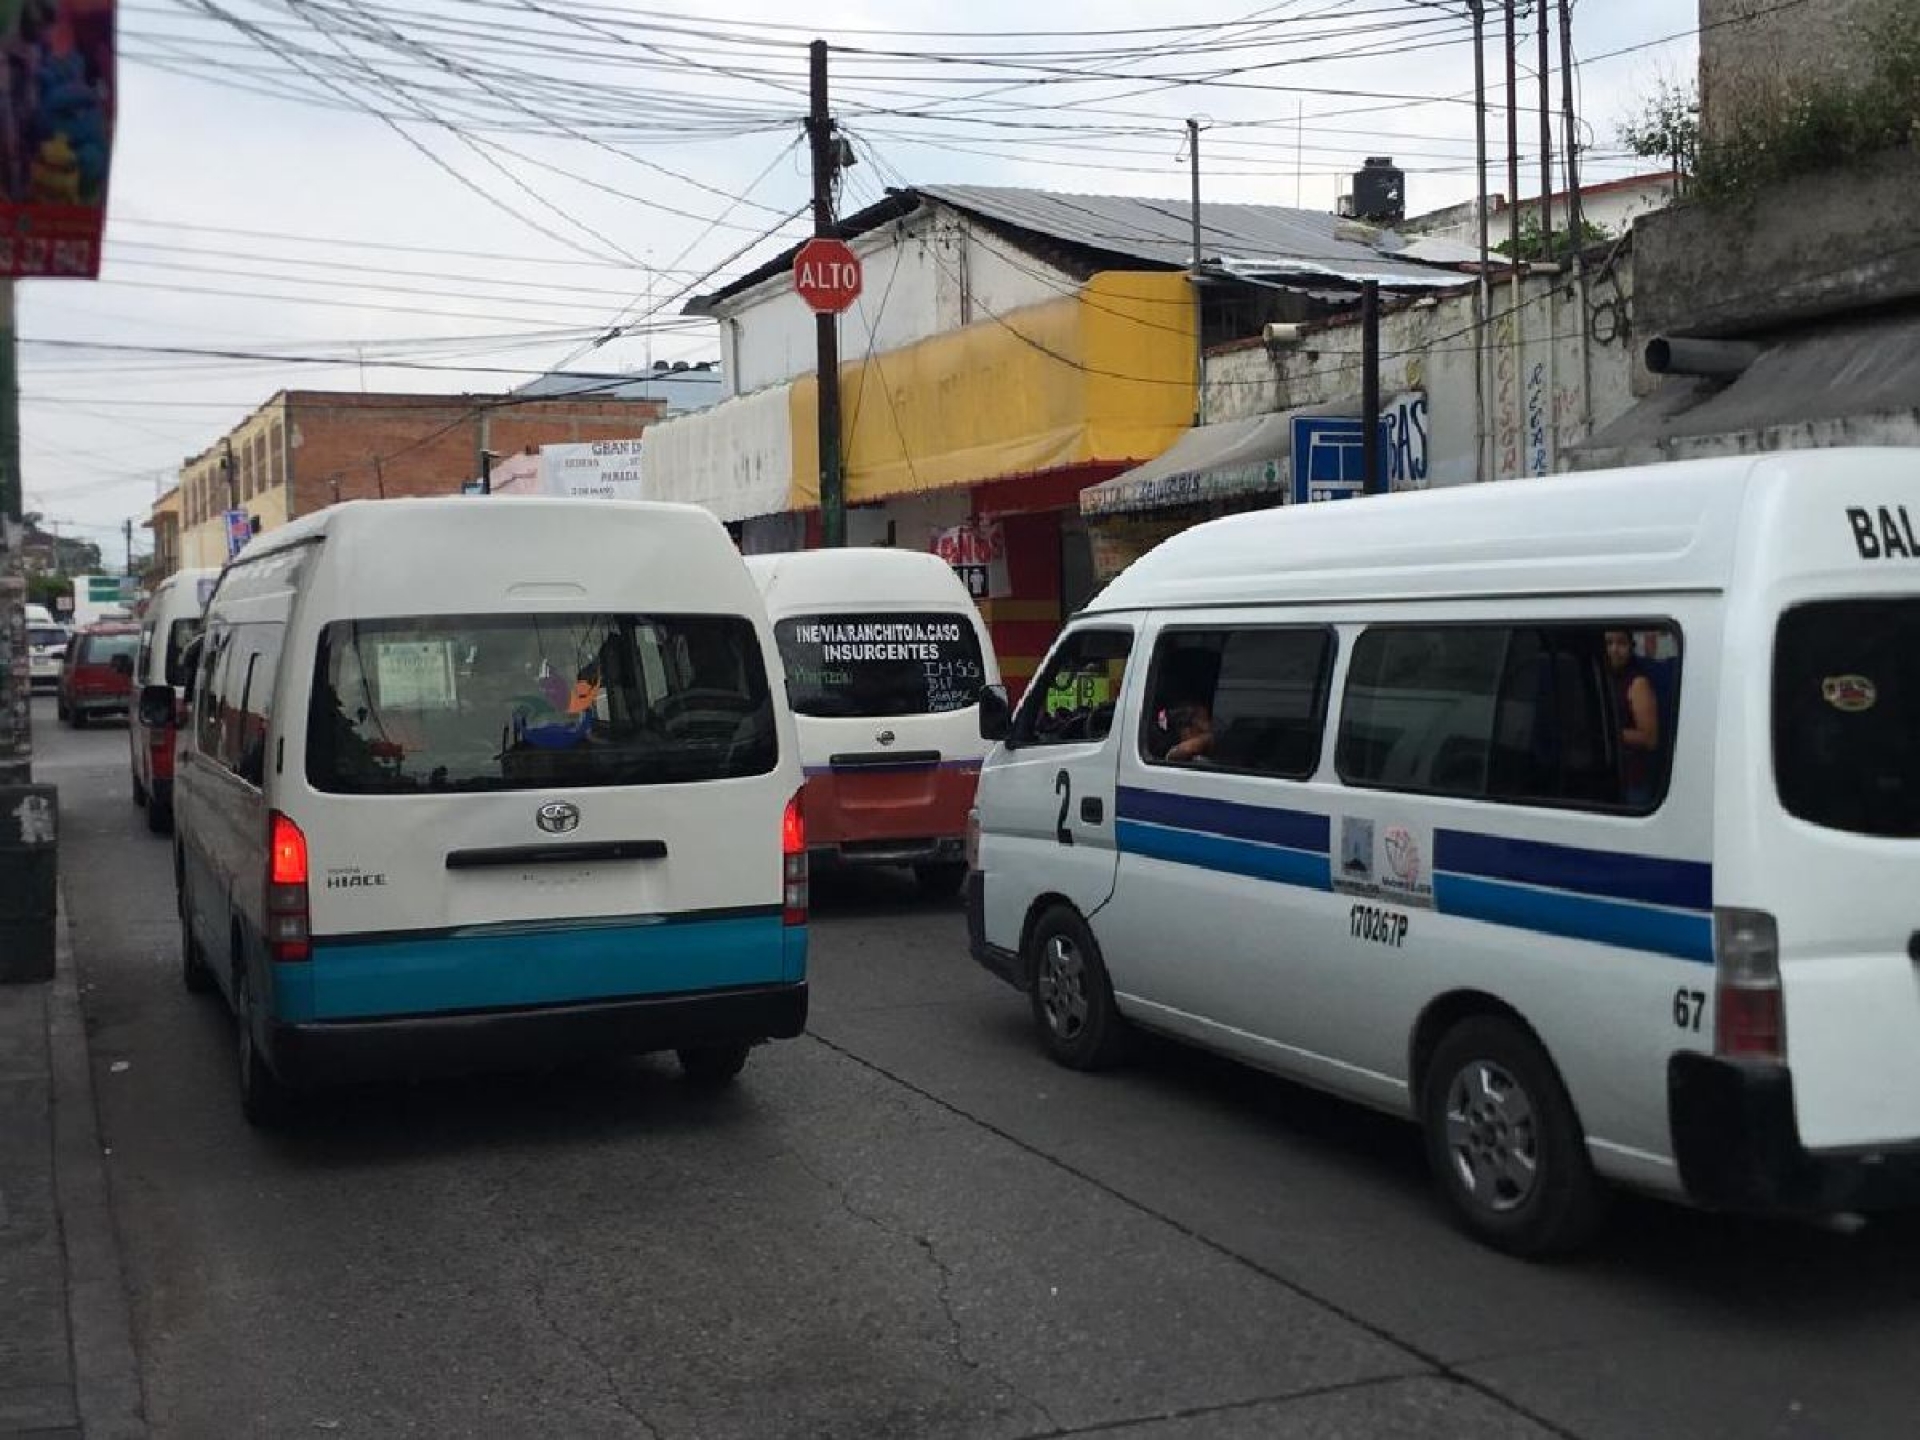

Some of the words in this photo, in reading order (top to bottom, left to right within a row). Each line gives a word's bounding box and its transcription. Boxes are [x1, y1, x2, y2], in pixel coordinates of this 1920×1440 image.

[799, 261, 856, 289] ALTO
[1846, 505, 1920, 559] BAL
[823, 644, 940, 661] INSURGENTES
[1056, 768, 1075, 847] 2
[327, 873, 388, 889] HIACE
[1350, 903, 1408, 947] 170267P
[1674, 986, 1706, 1033] 67
